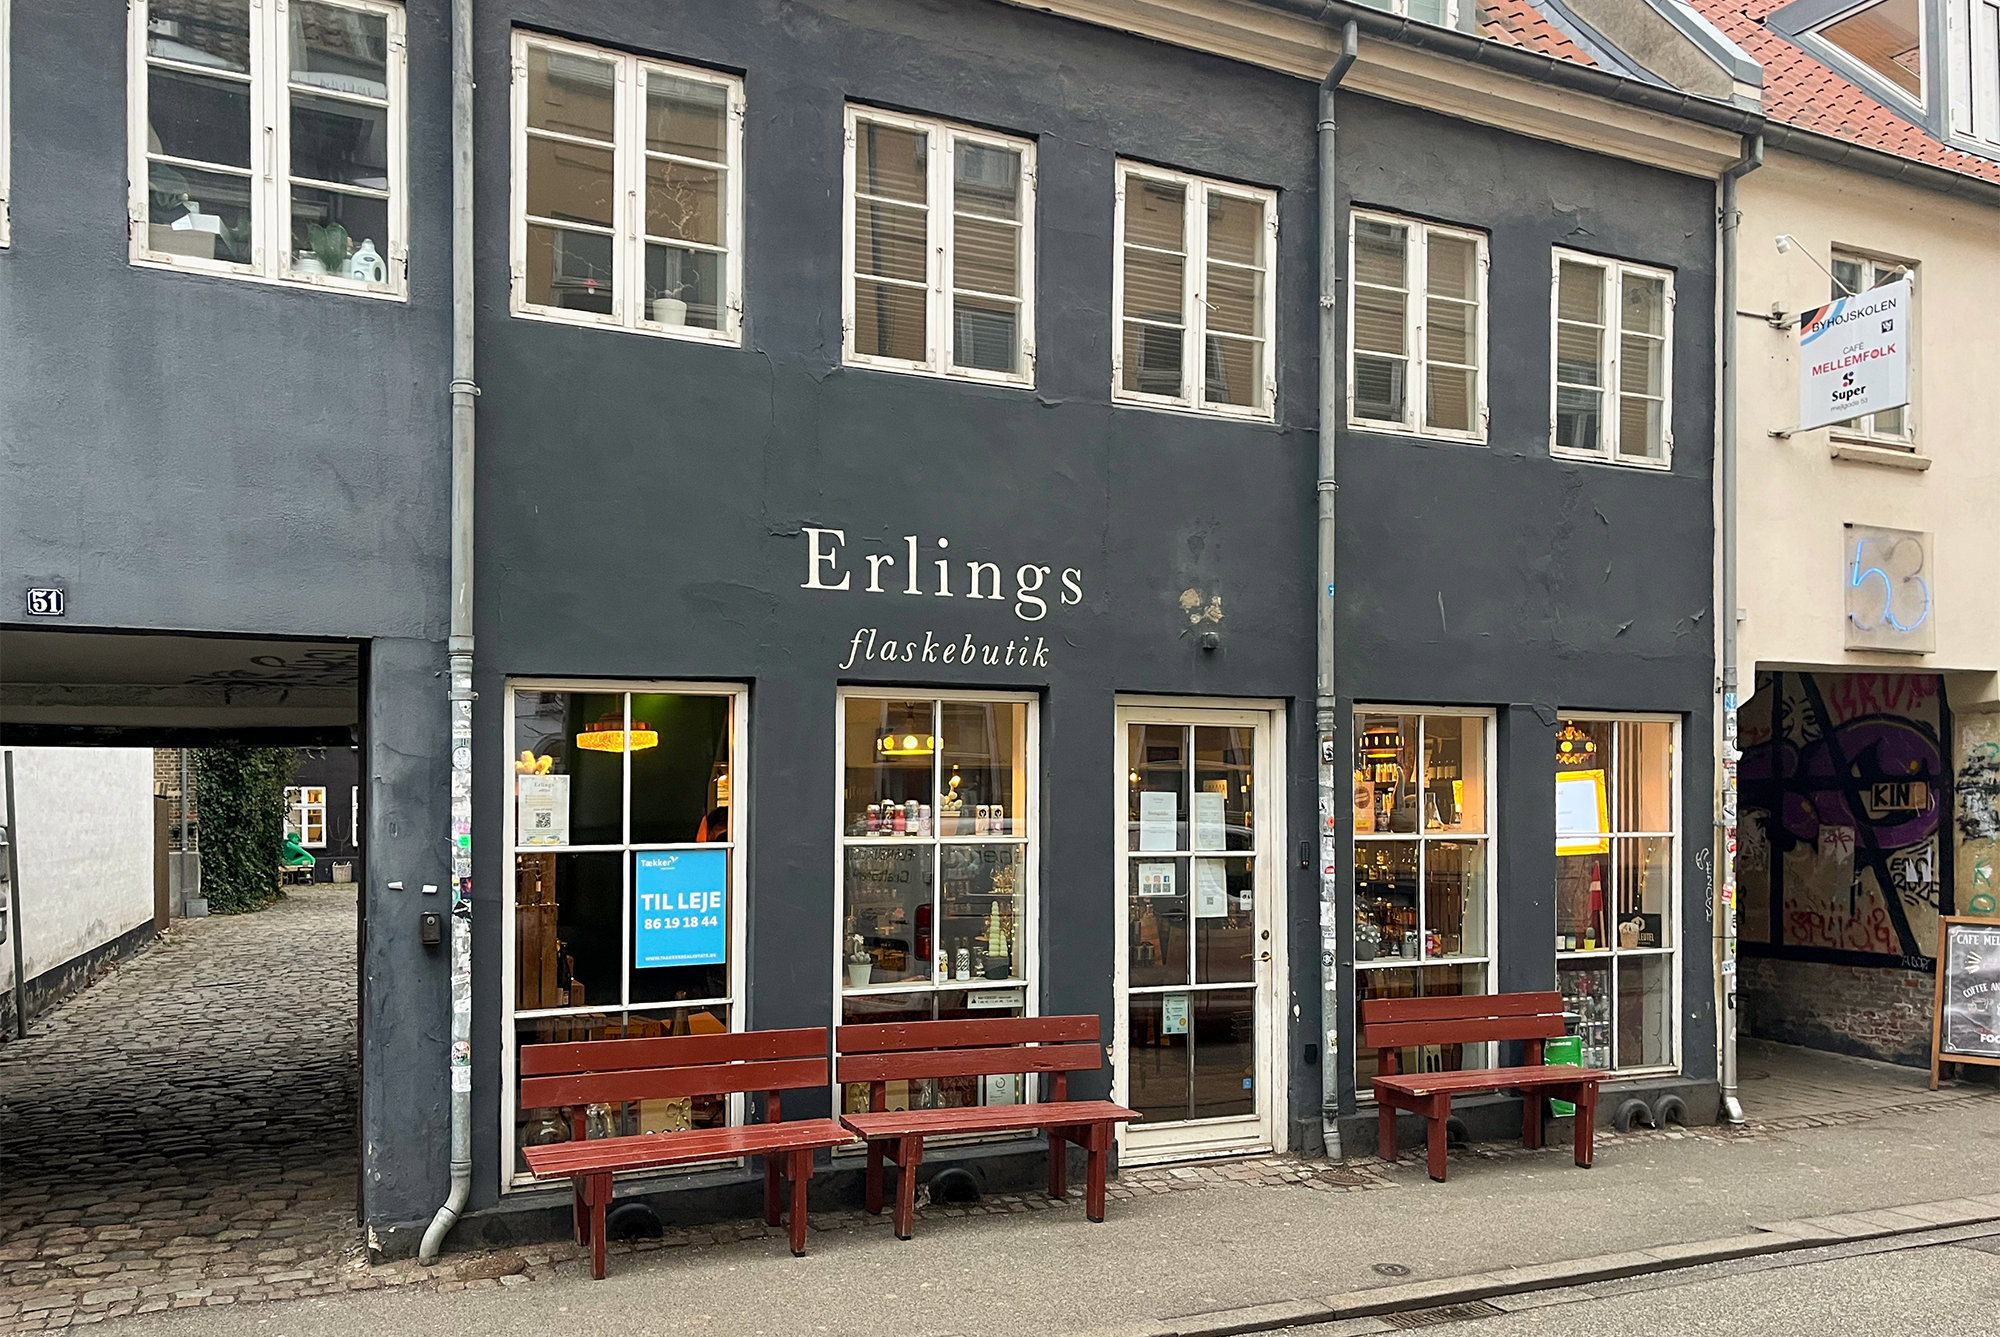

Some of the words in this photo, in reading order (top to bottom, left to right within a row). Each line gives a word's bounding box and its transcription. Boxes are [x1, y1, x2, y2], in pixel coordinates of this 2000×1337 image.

[1832, 386, 1867, 402] Super
[800, 527, 1083, 621] Erlings
[1849, 536, 1930, 632] 53
[32, 591, 58, 612] 51
[838, 628, 1050, 669] flaskebutik
[1873, 784, 1910, 808] KIN
[640, 858, 672, 867] Tækker
[640, 893, 674, 911] TIL
[677, 891, 722, 914] LEJE
[643, 918, 661, 930] 86
[664, 917, 680, 929] 19
[682, 917, 698, 928] 18
[701, 915, 718, 927] 44
[1956, 934, 1979, 945] CAFE
[1962, 982, 1989, 999] COFFEE
